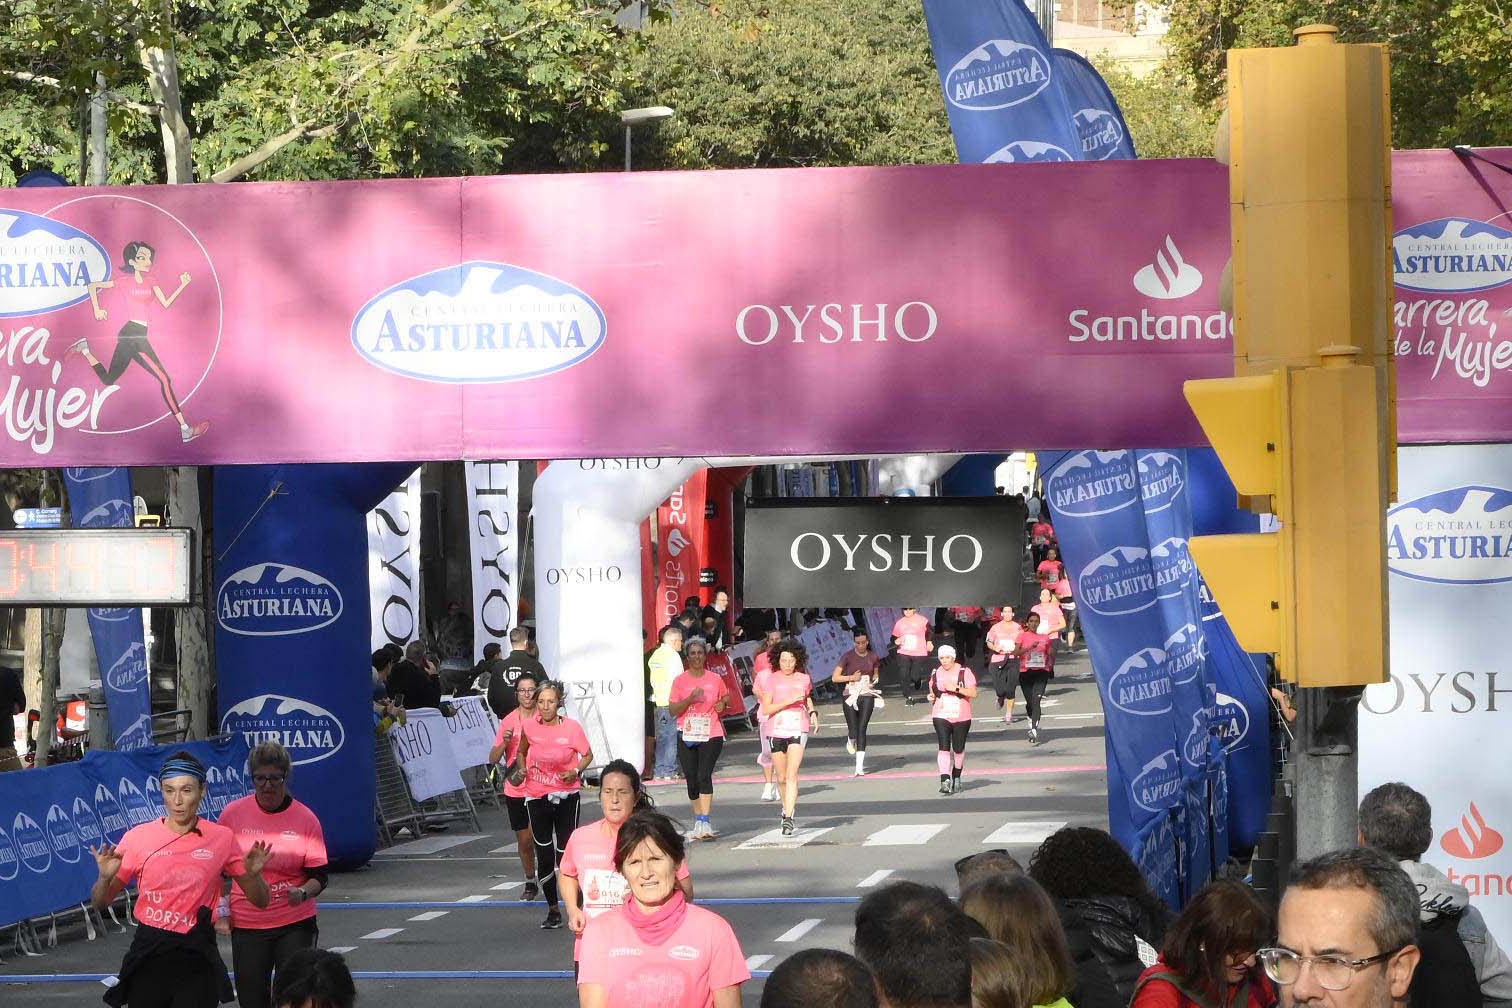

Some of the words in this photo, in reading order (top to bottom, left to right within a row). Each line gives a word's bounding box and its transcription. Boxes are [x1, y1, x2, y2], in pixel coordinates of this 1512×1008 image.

[1464, 240, 1512, 251] LECHER
[735, 300, 939, 346] OYSHO
[1394, 298, 1490, 328] arrera
[370, 308, 588, 354] ASTURIANA
[1417, 328, 1436, 356] la
[1430, 322, 1512, 388] Muje
[1414, 520, 1482, 532] CENTRAL
[789, 532, 984, 574] OYSHO
[546, 565, 622, 586] OYSHO
[233, 587, 277, 597] CENTRAL
[279, 586, 330, 596] LECHERA
[220, 592, 334, 620] ASTURIANA
[1361, 669, 1512, 716] OYSH
[234, 719, 277, 729] CENTRAL
[280, 718, 330, 728] LECHERA
[144, 890, 162, 904] TU
[146, 906, 196, 928] DORSAL
